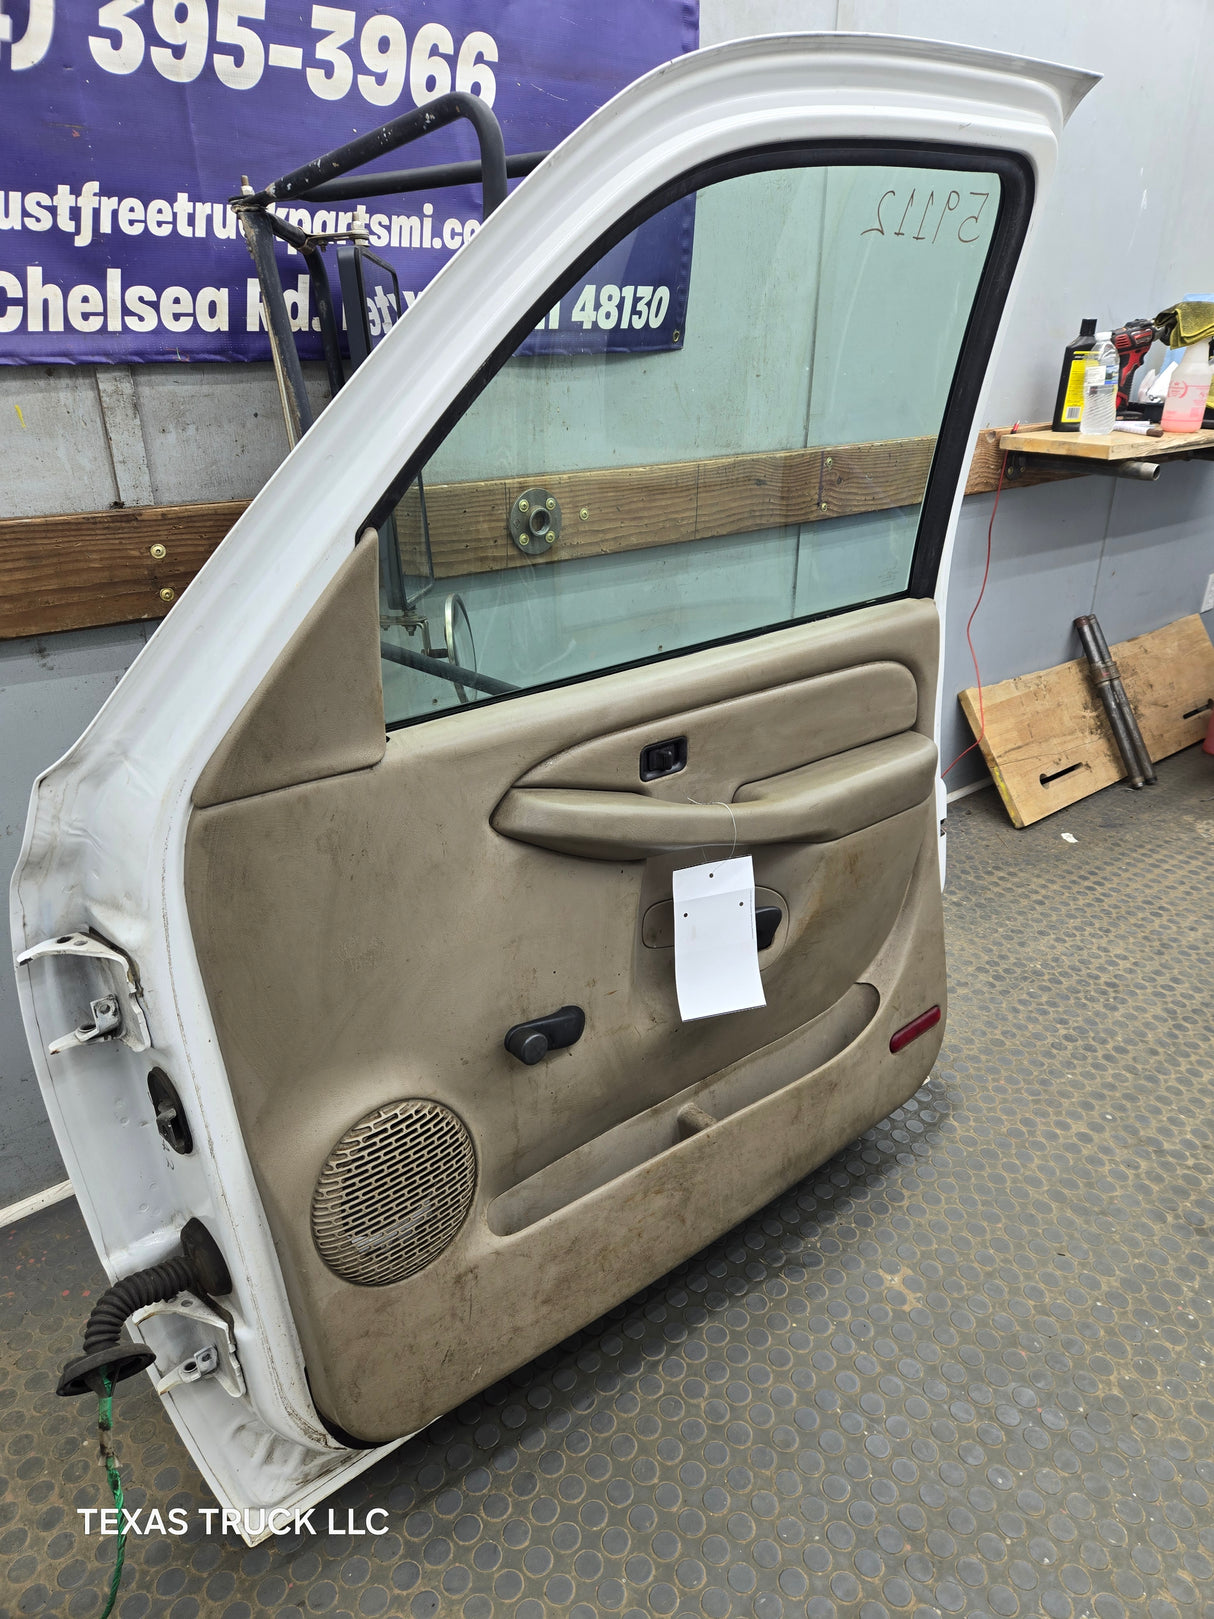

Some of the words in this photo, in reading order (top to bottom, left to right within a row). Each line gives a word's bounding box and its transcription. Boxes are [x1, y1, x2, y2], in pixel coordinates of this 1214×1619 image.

[88, 0, 499, 110] 395-3966
[0, 266, 229, 333] Chelsea
[571, 284, 670, 330] 48130
